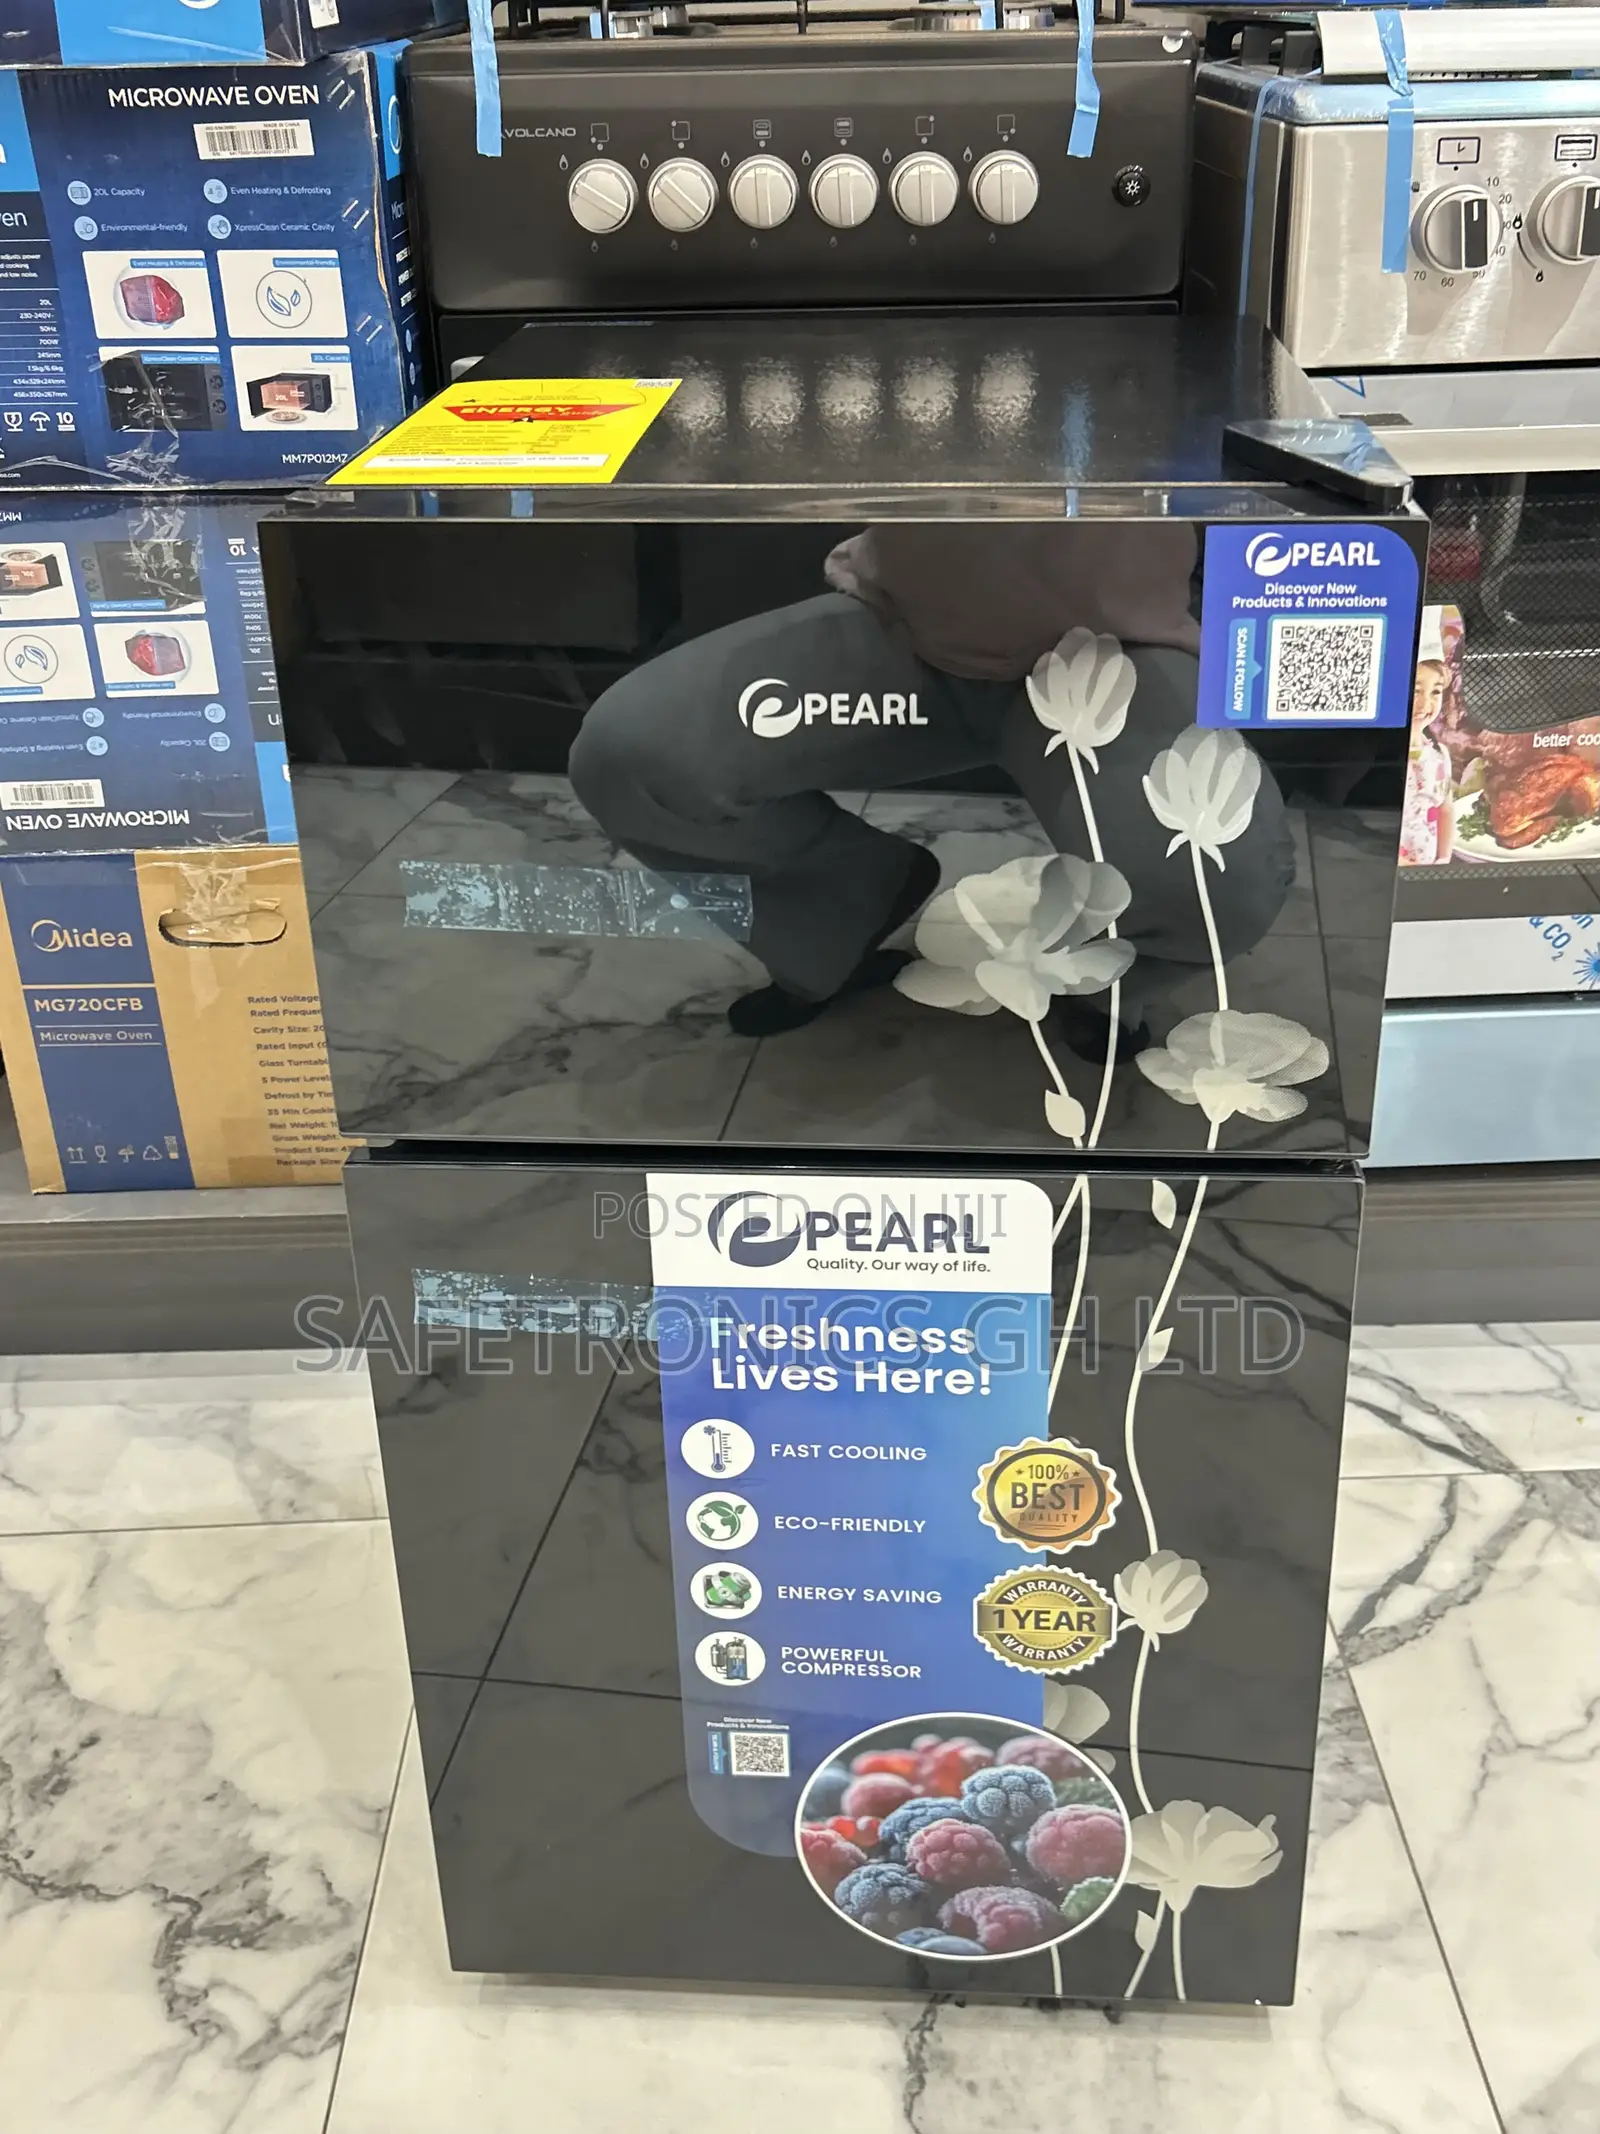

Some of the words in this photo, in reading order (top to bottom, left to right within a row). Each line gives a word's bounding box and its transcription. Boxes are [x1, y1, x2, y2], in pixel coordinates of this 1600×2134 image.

[108, 86, 250, 108] MICROWAVE
[254, 83, 321, 105] OVEN
[504, 127, 577, 138] VOLCANO
[1486, 176, 1500, 187] 10
[93, 187, 109, 196] 20L
[111, 187, 146, 198] Capacity
[230, 187, 249, 196] Even
[251, 186, 282, 197] Heating
[284, 187, 289, 195] &
[291, 186, 332, 197] Defrosting
[1499, 193, 1512, 204] 20
[0, 211, 28, 227] en
[101, 222, 188, 233] Environmental-friendly
[234, 223, 279, 234] XpressClean
[280, 223, 311, 232] Ceramic
[312, 222, 335, 233] Cavity
[1413, 270, 1427, 281] 70
[1441, 276, 1455, 288] 60
[56, 411, 74, 425] 10
[459, 405, 574, 415] ENERGY
[1290, 541, 1381, 567] PEARL
[1264, 582, 1325, 596] Discover
[1326, 582, 1357, 595] New
[1232, 596, 1293, 609] Products
[1295, 596, 1305, 608] &
[1307, 595, 1388, 609] Innovations
[804, 692, 929, 726] PEARL
[1532, 732, 1574, 749] better
[6, 812, 63, 832] OVEN
[66, 809, 190, 831] MICROWAVE
[31, 919, 133, 953] Midea
[34, 997, 144, 1013] MG720CFB
[247, 995, 278, 1004] Rated
[281, 994, 319, 1004] Voltage
[250, 1009, 280, 1018] Rated
[40, 1030, 113, 1042] Microwave
[116, 1029, 153, 1041] Oven
[253, 1026, 284, 1035] Cavity
[256, 1043, 286, 1051] Rated
[806, 1210, 991, 1255] PEARL
[806, 1257, 868, 1273] Quality.
[871, 1258, 901, 1272] Our
[904, 1260, 939, 1275] way
[942, 1259, 960, 1273] of
[962, 1259, 992, 1273] life.
[709, 1315, 976, 1355] Freshness
[711, 1354, 840, 1392] Lives
[854, 1360, 993, 1397] Here!
[770, 1443, 823, 1459] FAST
[827, 1444, 928, 1462] COOLING
[1028, 1463, 1071, 1481] 100%
[1010, 1481, 1086, 1511] BEST
[774, 1515, 927, 1534] ECO-FRIENDLY
[1019, 1511, 1079, 1524] QUALITY
[777, 1584, 857, 1602] ENERGY
[862, 1587, 943, 1604] SAVING
[1002, 1579, 1089, 1605] WARRANTY
[992, 1609, 1006, 1630] 1
[1010, 1608, 1098, 1633] YEAR
[780, 1646, 889, 1663] POWERFUL
[1001, 1634, 1087, 1661] WARRANTY
[780, 1661, 923, 1679] COMPRESSOR
